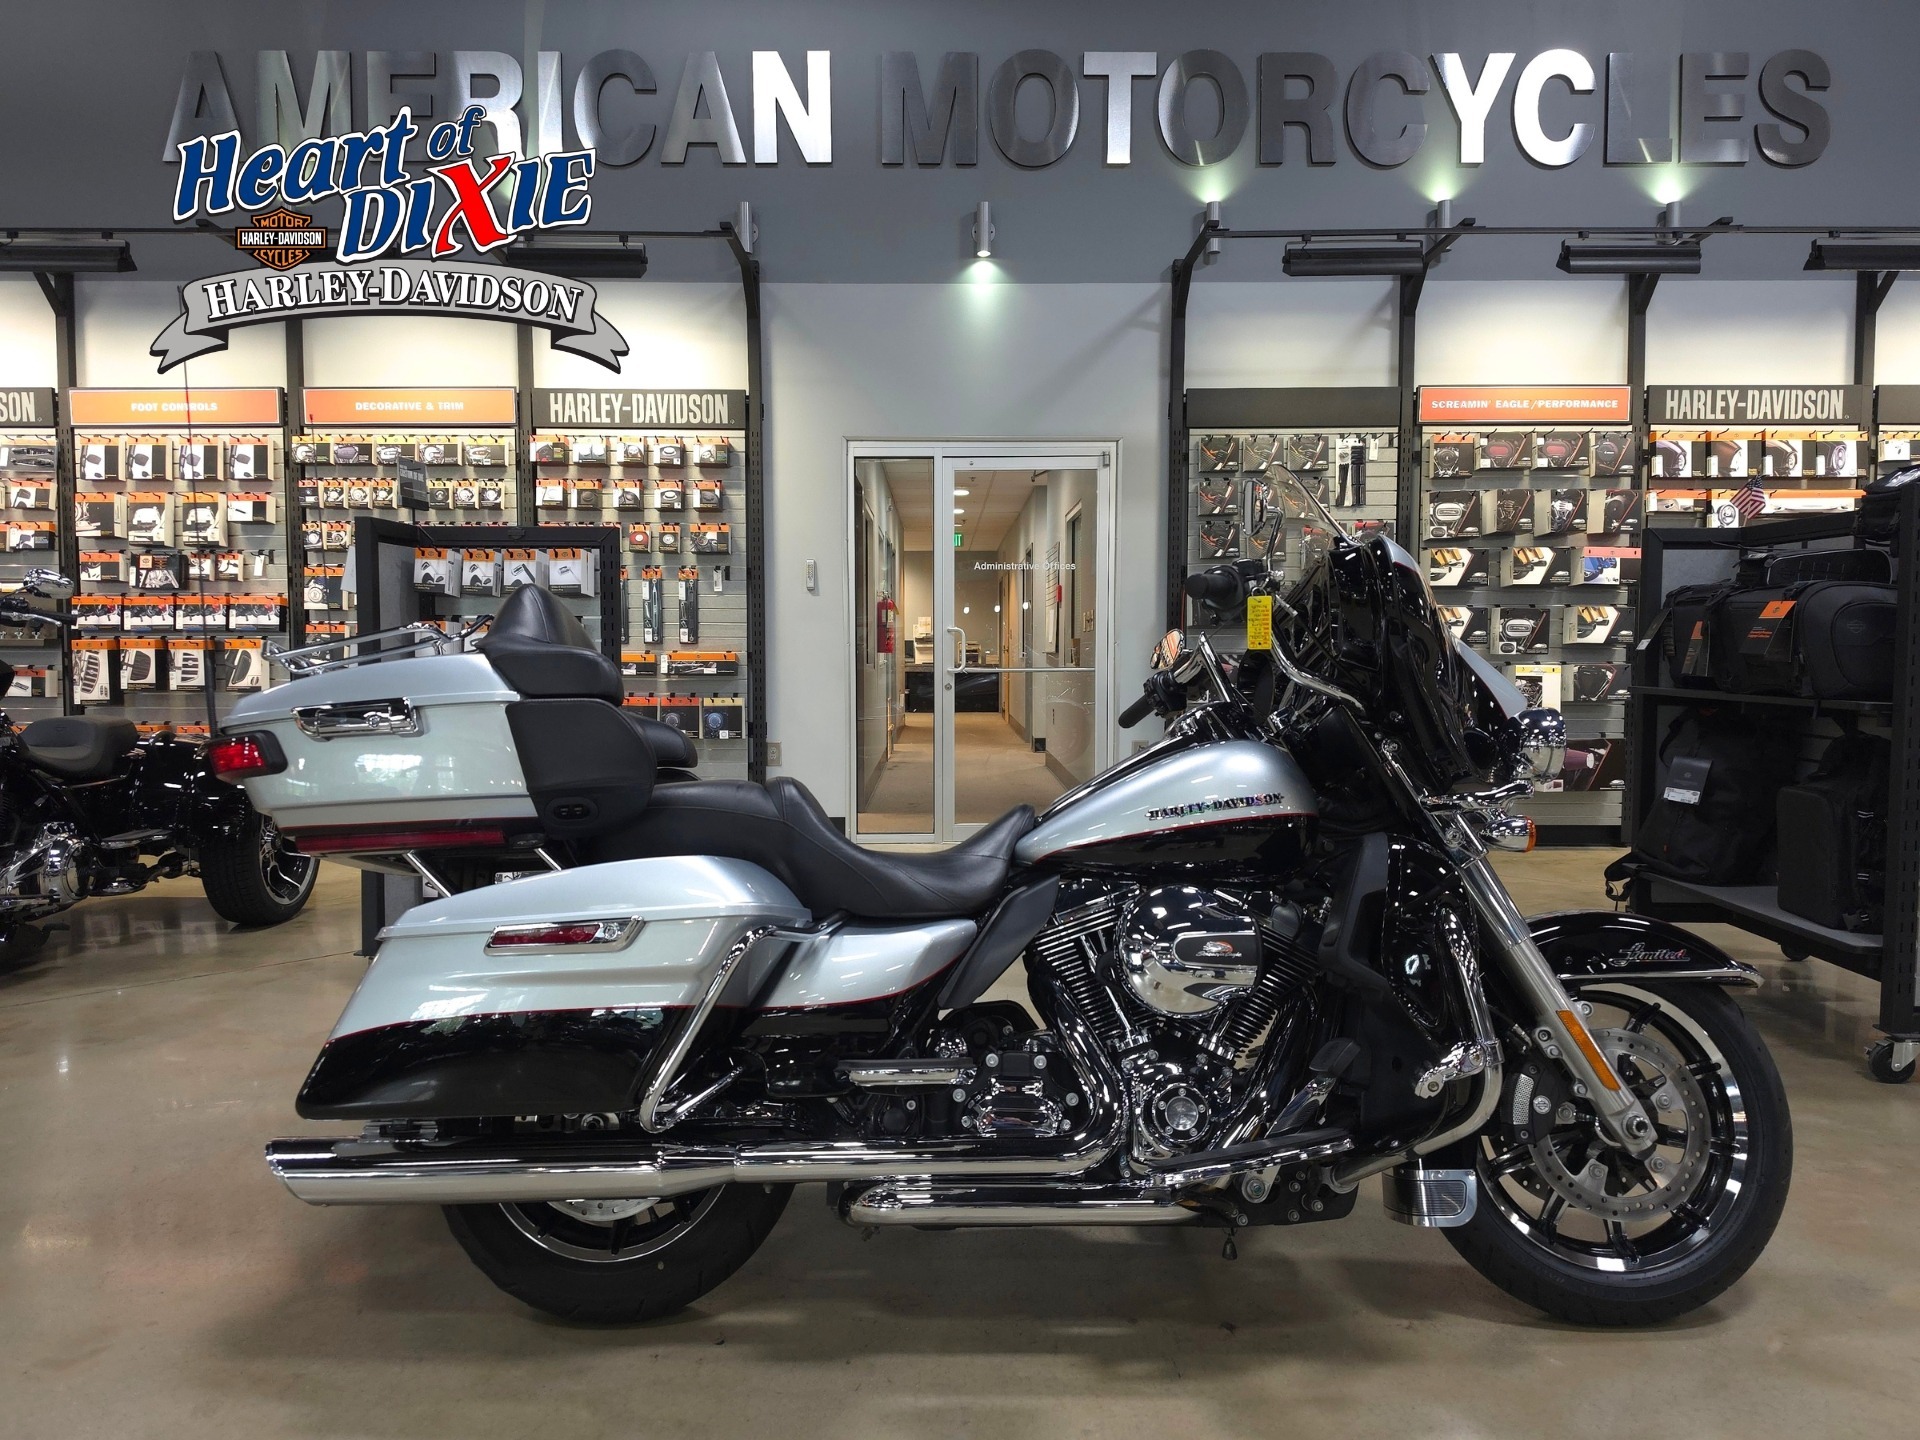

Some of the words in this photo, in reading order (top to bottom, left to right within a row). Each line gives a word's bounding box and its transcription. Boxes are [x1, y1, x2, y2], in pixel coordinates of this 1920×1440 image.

[161, 50, 834, 166] AMERICAN
[879, 49, 1832, 167] MOTORCYCLES
[131, 402, 158, 412] FOOT
[161, 402, 218, 411] CONTROLS
[355, 401, 422, 411] DECORATIVE
[425, 402, 434, 411] &
[438, 401, 464, 411] TRIM
[550, 392, 729, 424] HARLEY-DAVIDSON
[1665, 389, 1844, 420] HARLEY-DAVIDSON
[974, 561, 1040, 570] Administrative
[1043, 561, 1076, 570] Offices
[1147, 792, 1284, 820] HARLEY-DAVIDSON
[1608, 941, 1691, 967] Limited
